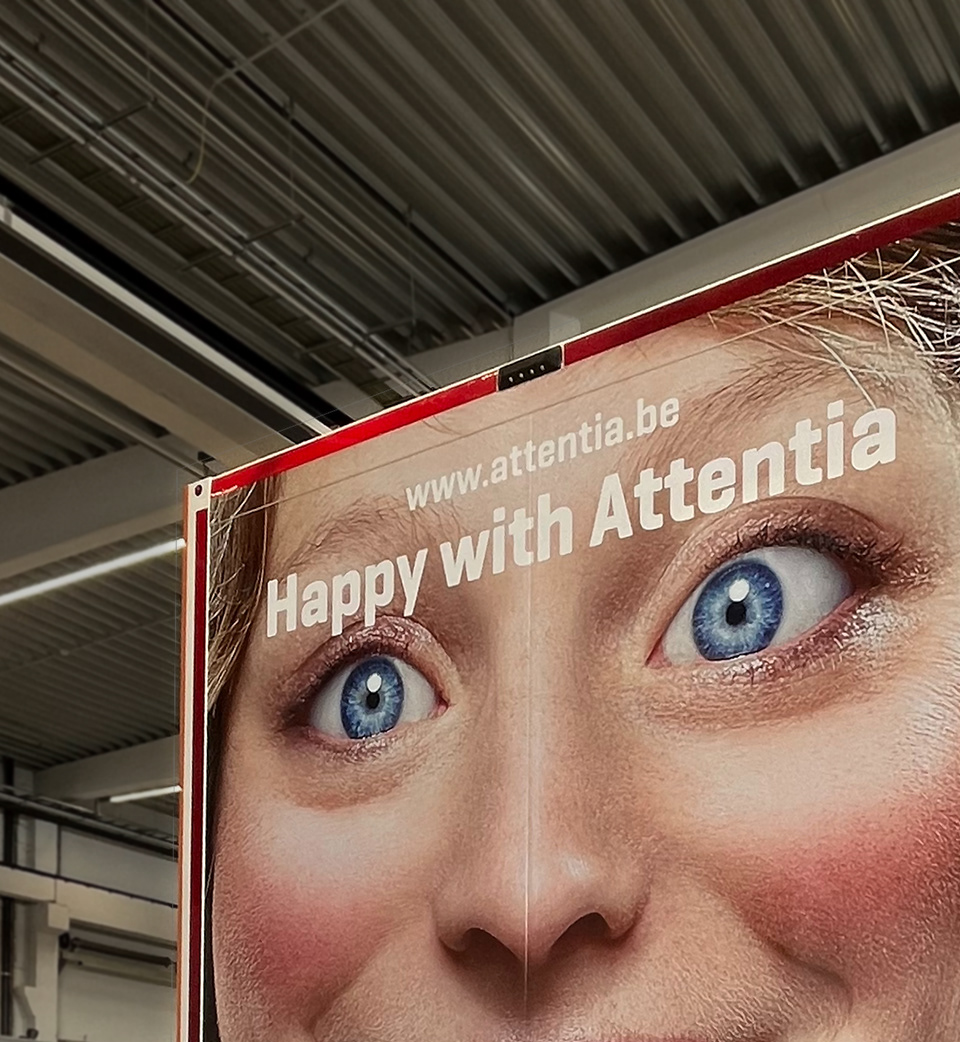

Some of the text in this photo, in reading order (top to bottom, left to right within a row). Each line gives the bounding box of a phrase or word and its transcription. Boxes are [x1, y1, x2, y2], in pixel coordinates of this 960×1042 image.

[266, 399, 897, 638] Happy with Attentia
[405, 395, 681, 511] www.attentia.be
